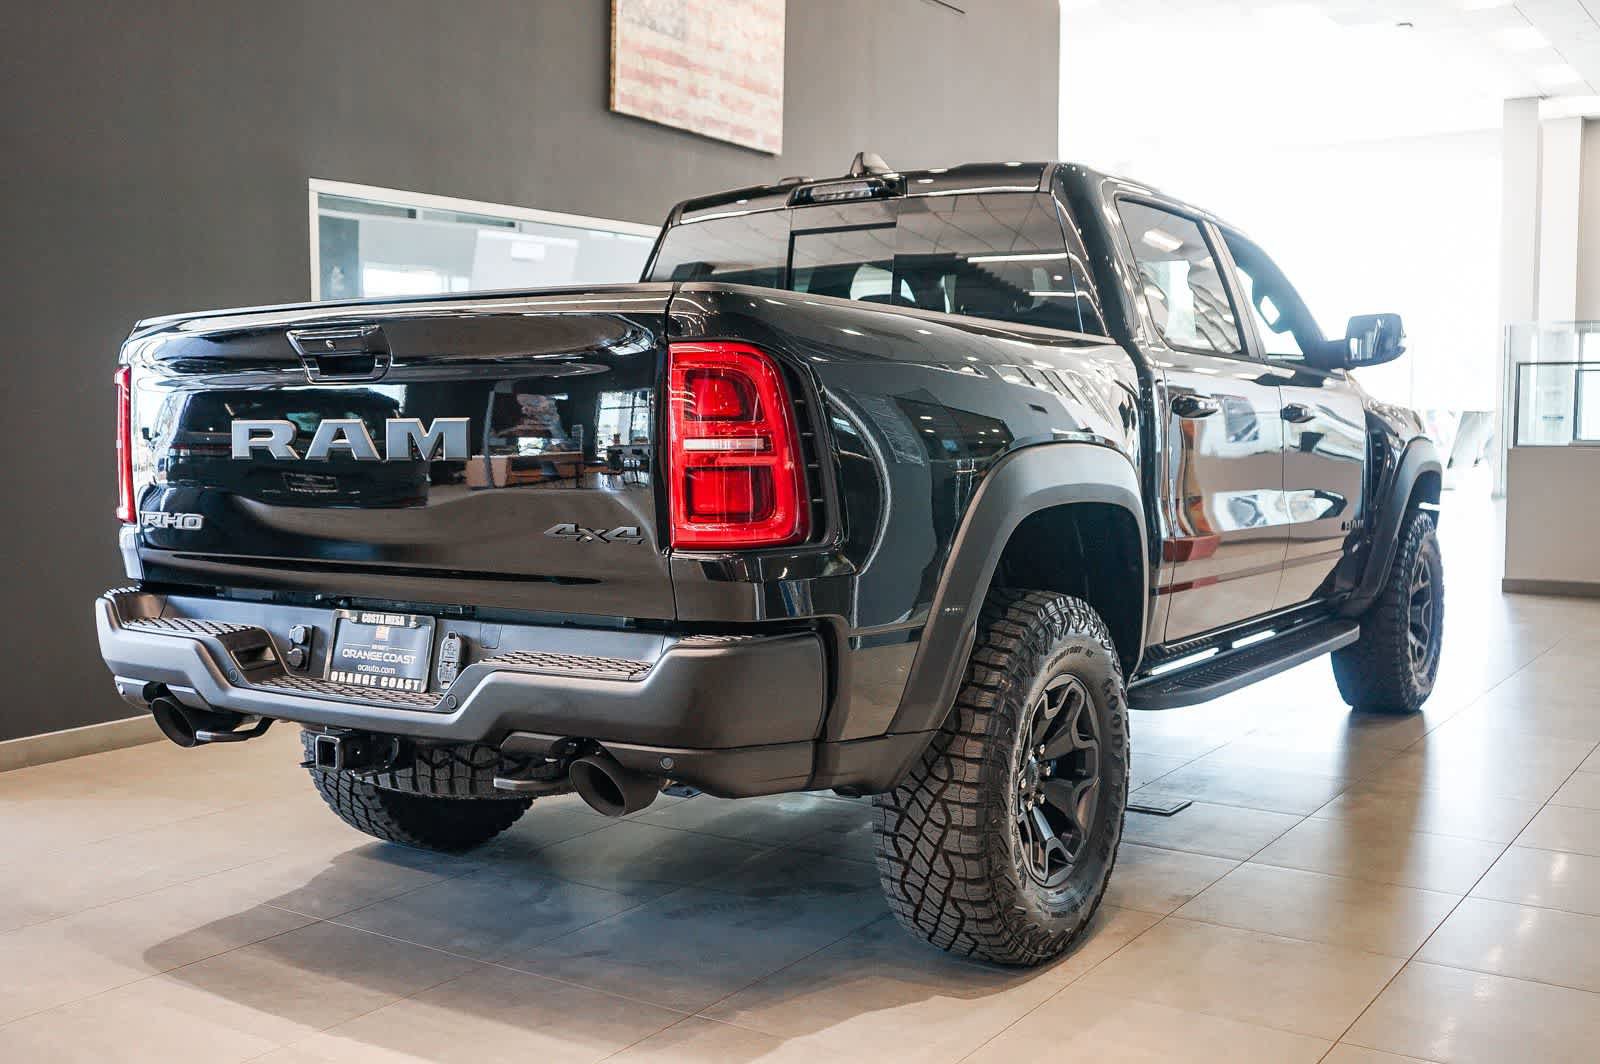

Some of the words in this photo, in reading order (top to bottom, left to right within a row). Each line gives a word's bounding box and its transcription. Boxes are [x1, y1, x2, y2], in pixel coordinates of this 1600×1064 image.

[231, 418, 470, 461] RAM
[140, 511, 204, 530] RHO
[361, 613, 384, 625] COSTA
[384, 614, 405, 626] MESA
[342, 648, 382, 661] ORANGE
[382, 652, 417, 665] COAST
[357, 663, 395, 674] ocauto.com
[331, 671, 377, 685] ORANGE
[380, 676, 420, 691] COAST
